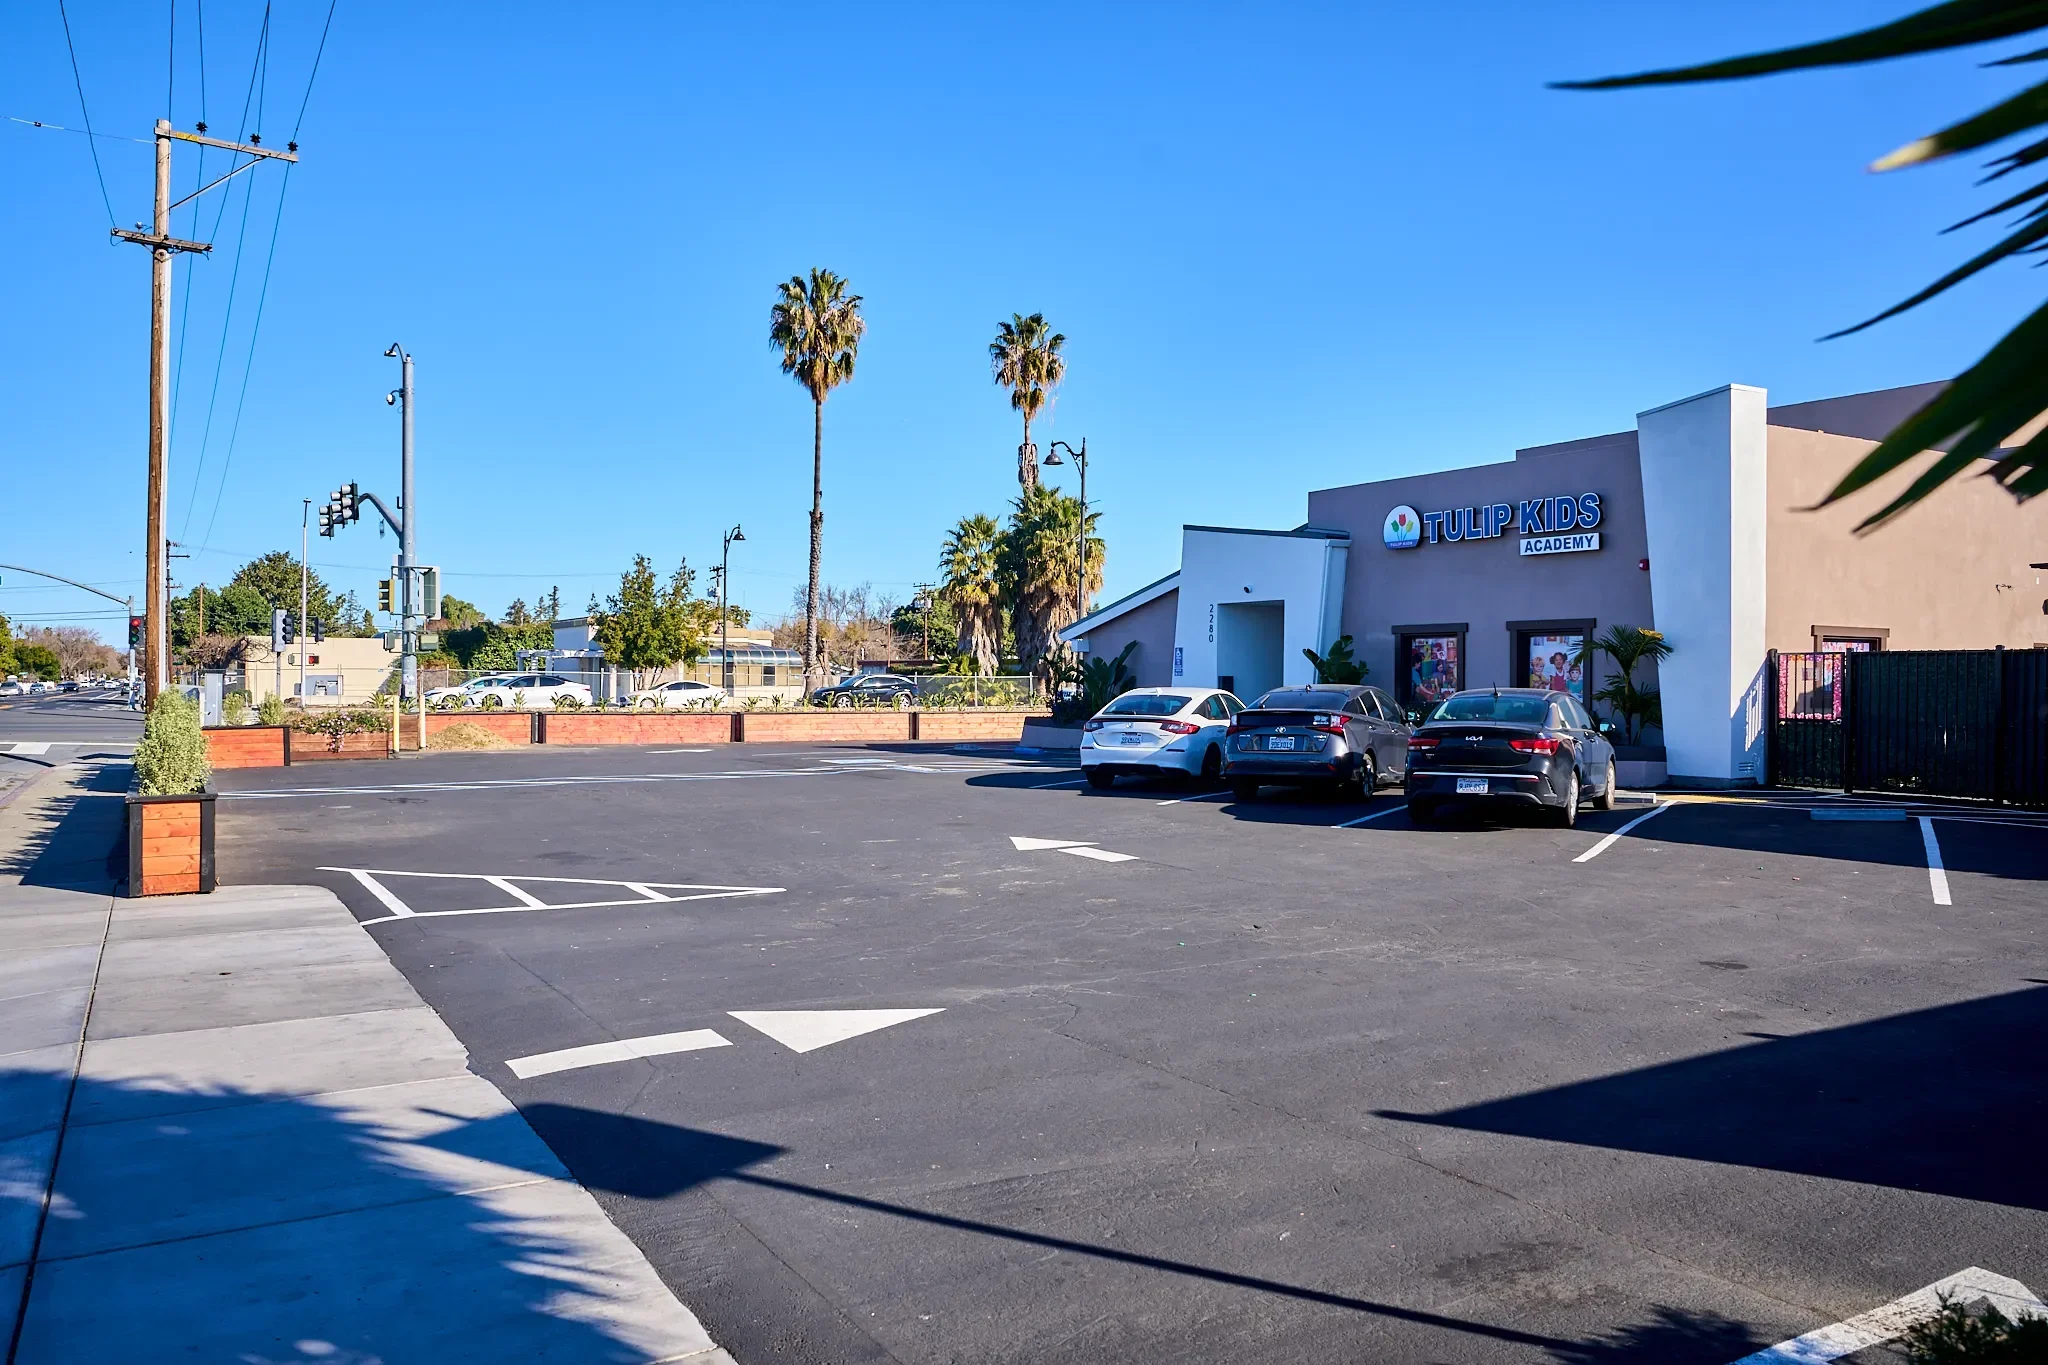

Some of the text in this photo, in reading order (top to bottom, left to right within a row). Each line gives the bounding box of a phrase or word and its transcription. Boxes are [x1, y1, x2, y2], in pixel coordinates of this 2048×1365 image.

[1424, 492, 1600, 544] TULIP KIDS
[1525, 535, 1594, 552] ACADEMY
